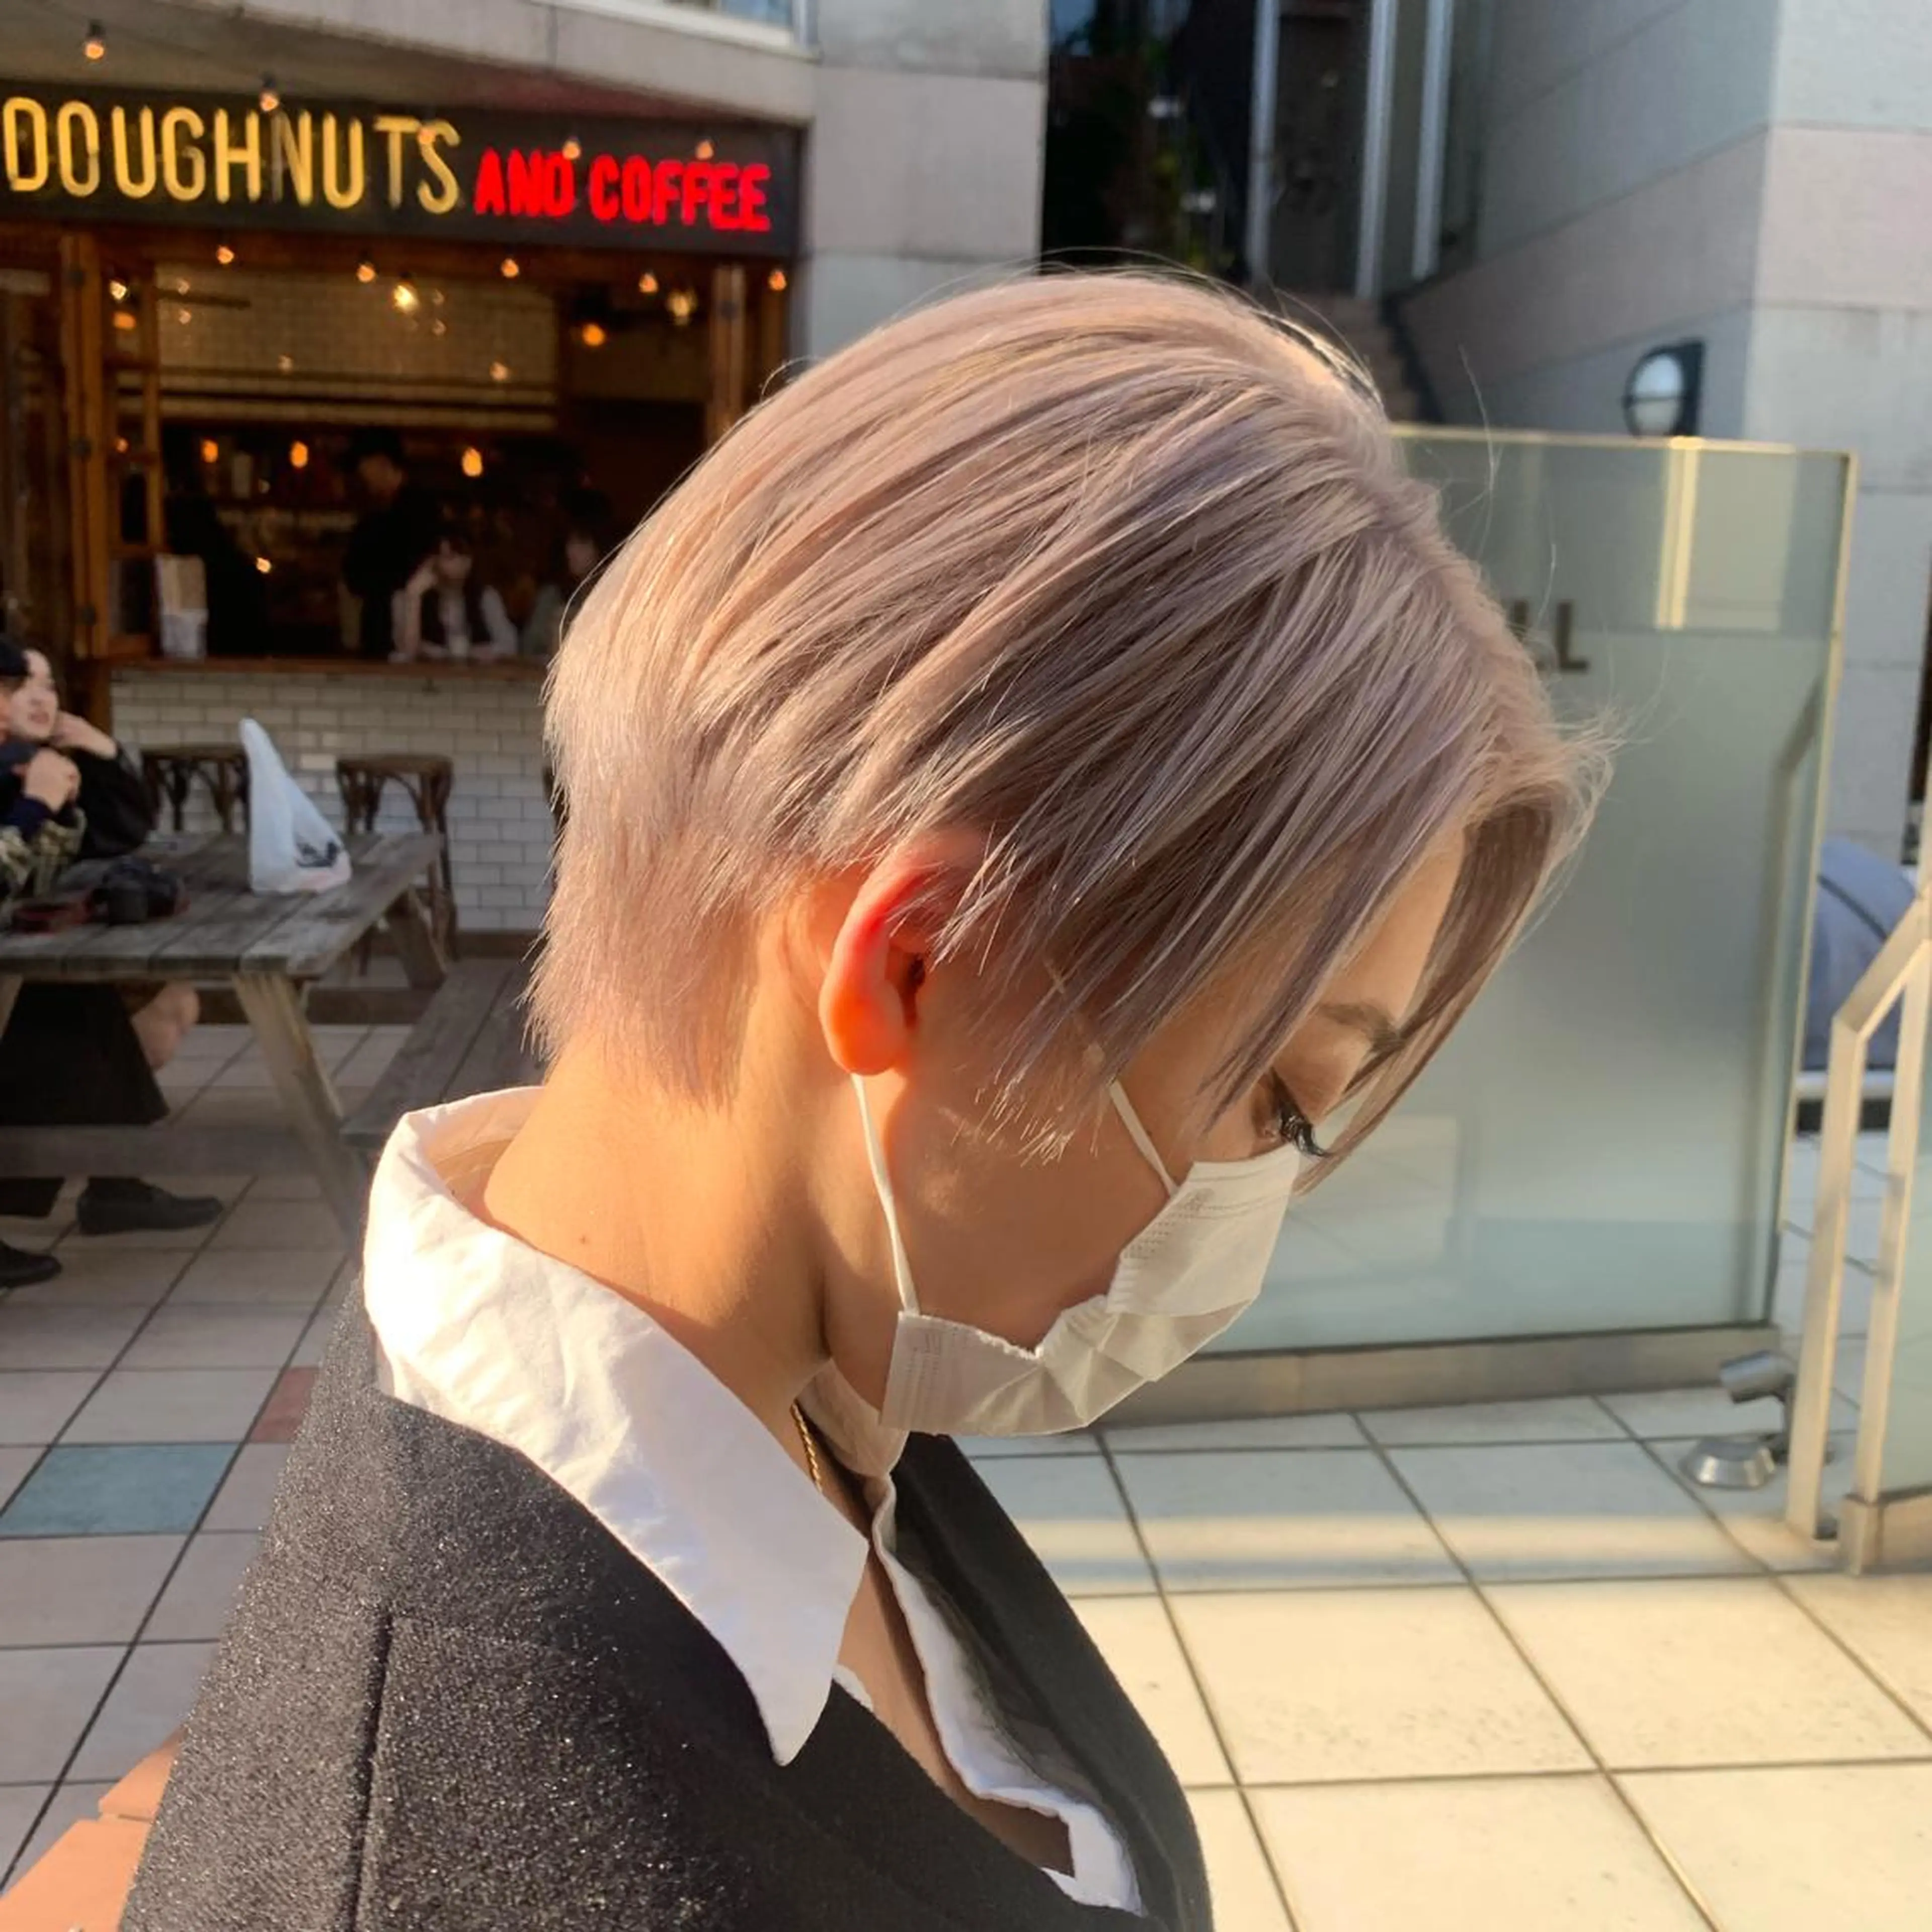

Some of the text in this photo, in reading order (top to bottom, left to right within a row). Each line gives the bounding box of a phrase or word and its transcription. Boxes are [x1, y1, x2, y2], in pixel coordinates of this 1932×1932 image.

[3, 97, 771, 231] DOUGHNUTS AND COFFEE
